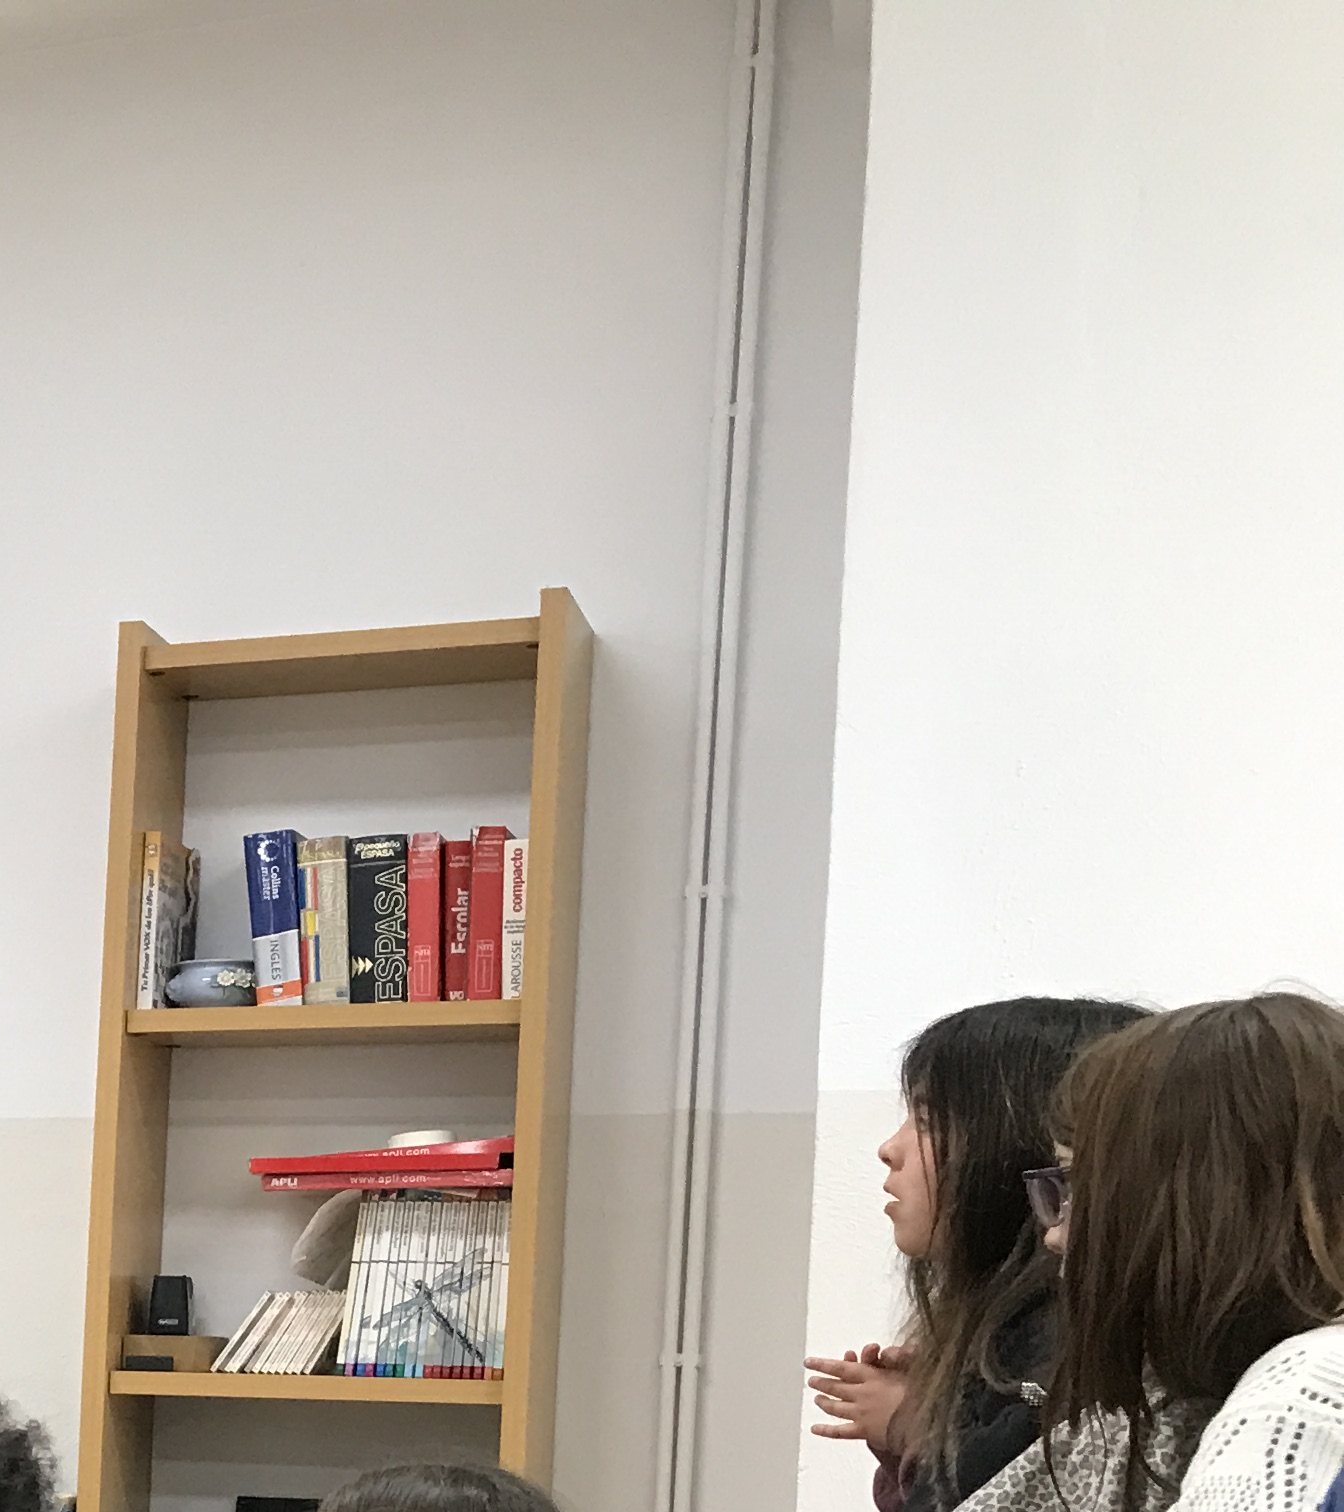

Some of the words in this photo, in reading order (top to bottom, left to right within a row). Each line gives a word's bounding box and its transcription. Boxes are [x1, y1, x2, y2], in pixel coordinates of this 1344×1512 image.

[262, 866, 271, 901] master
[270, 866, 280, 900] Collins
[513, 847, 524, 913] compacto
[374, 864, 407, 1003] ESPASA
[510, 938, 522, 1000] LAROUSSE
